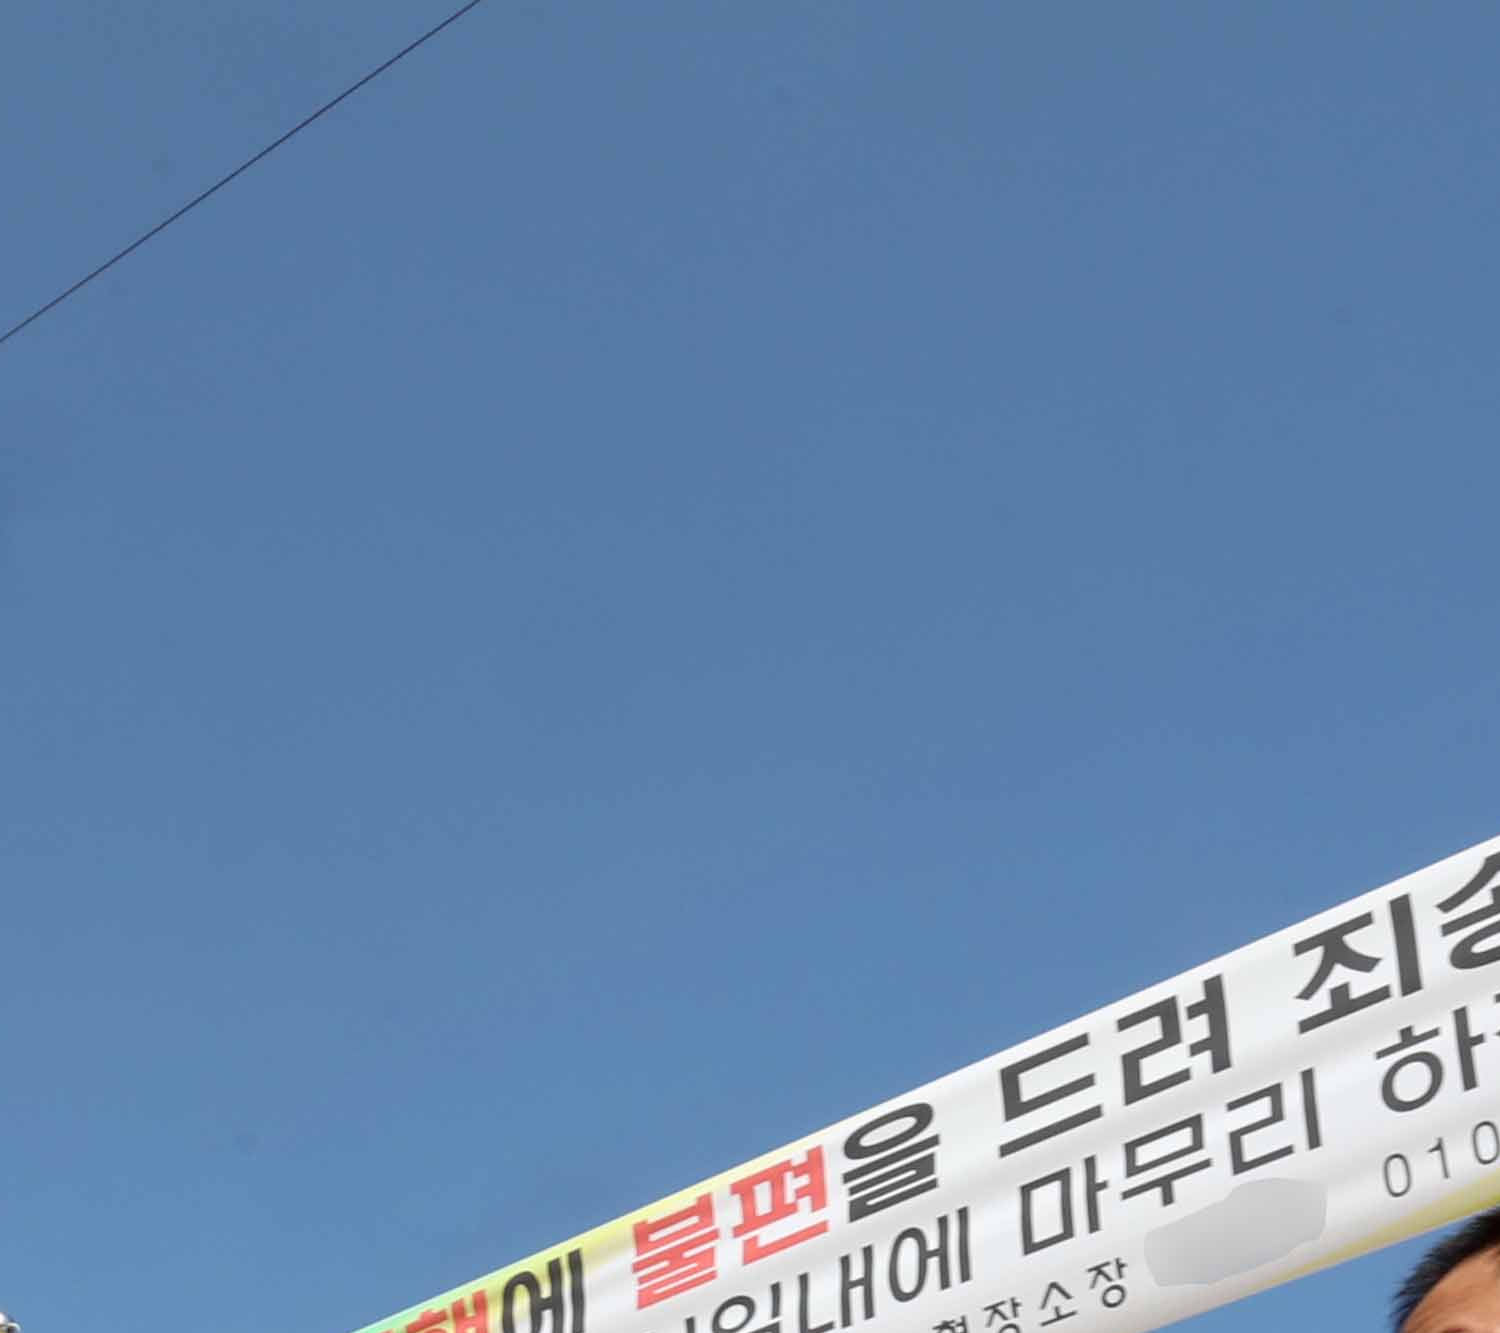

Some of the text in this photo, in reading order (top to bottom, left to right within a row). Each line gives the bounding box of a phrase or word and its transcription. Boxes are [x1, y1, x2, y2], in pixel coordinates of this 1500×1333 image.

[631, 1100, 940, 1310] 불편을
[998, 973, 1232, 1158] 드려
[1020, 1068, 1324, 1255] 마무리
